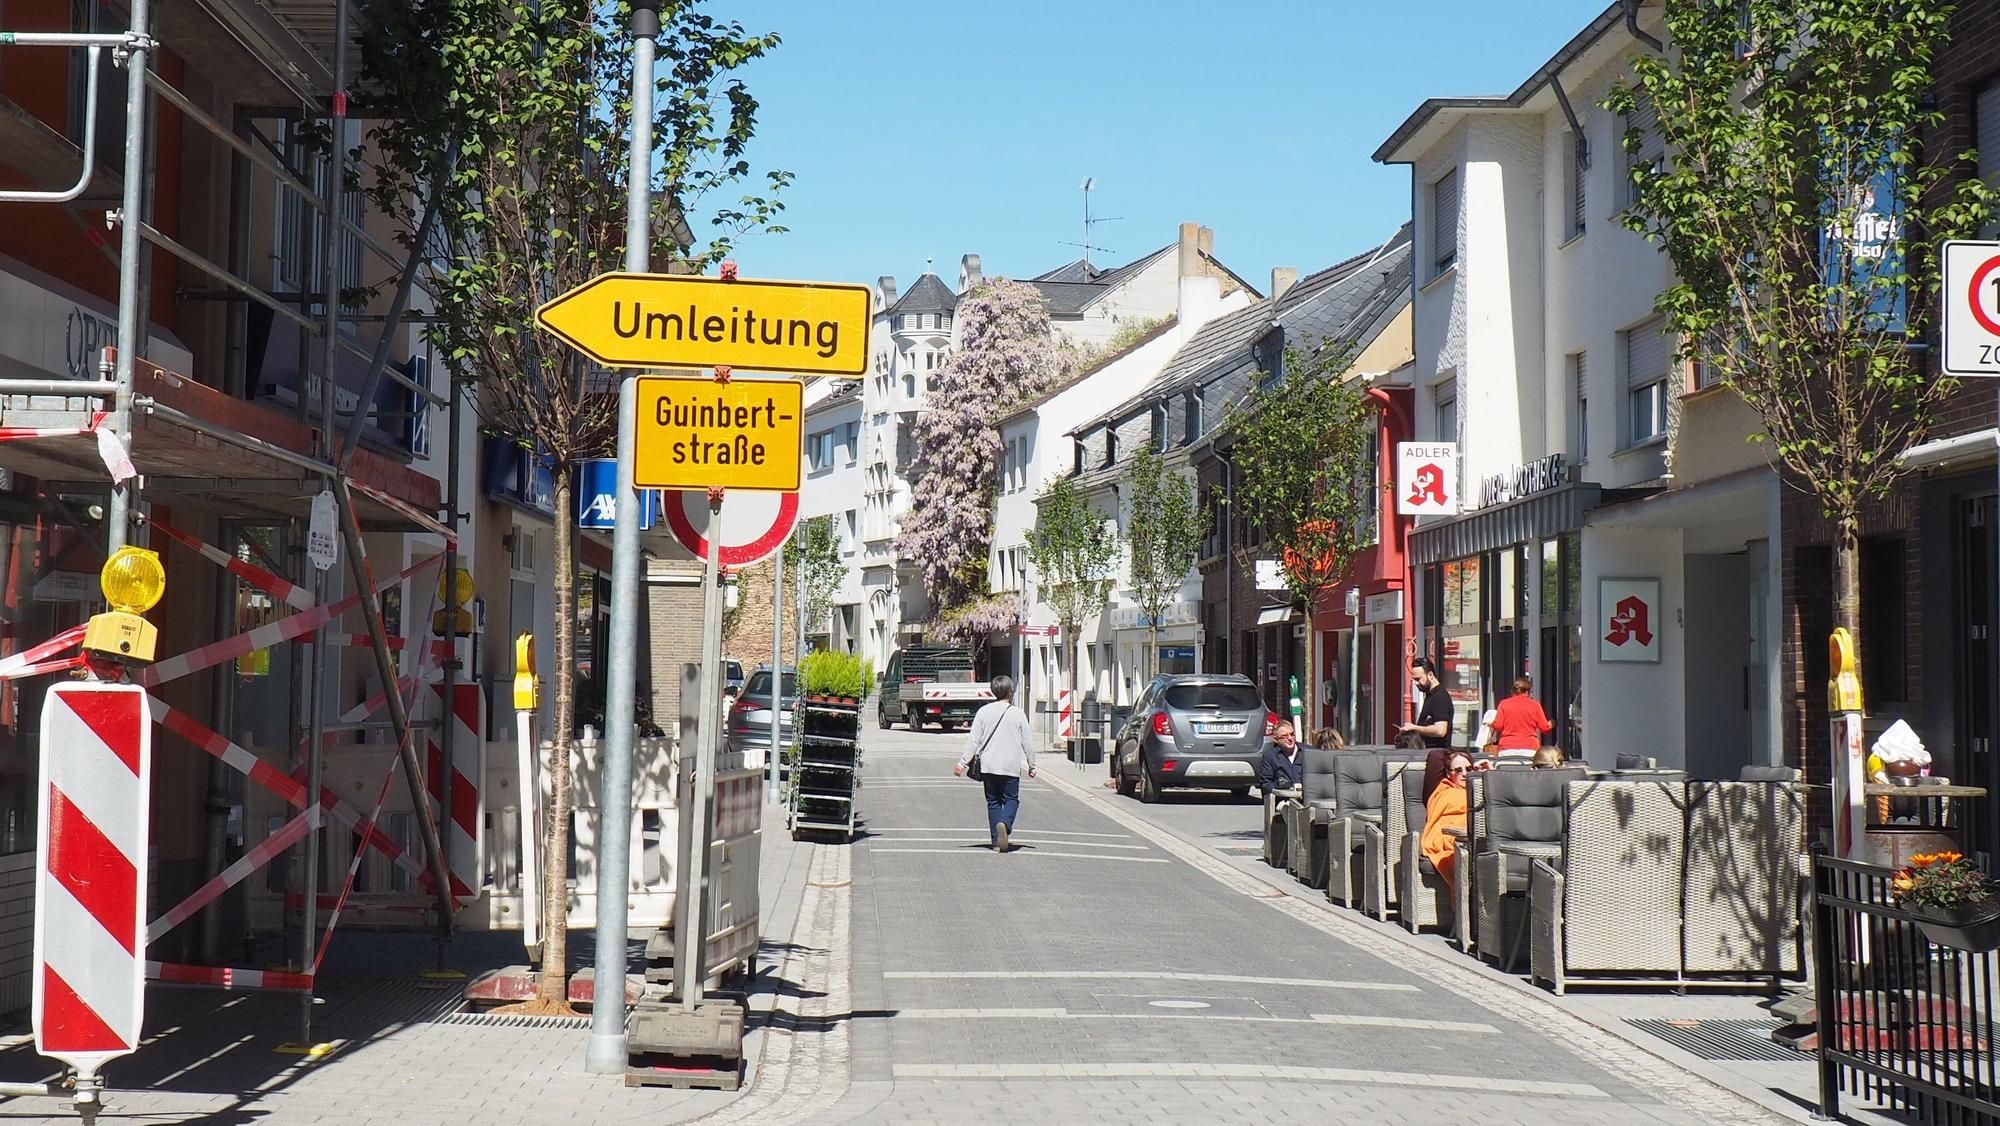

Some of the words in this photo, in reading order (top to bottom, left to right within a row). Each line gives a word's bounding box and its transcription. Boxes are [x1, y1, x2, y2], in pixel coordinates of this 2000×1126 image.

[613, 301, 839, 358] Umleitung
[656, 395, 793, 429] Guinbert-
[672, 434, 766, 465] straße
[1405, 447, 1451, 458] ADLER
[581, 493, 616, 520] AX
